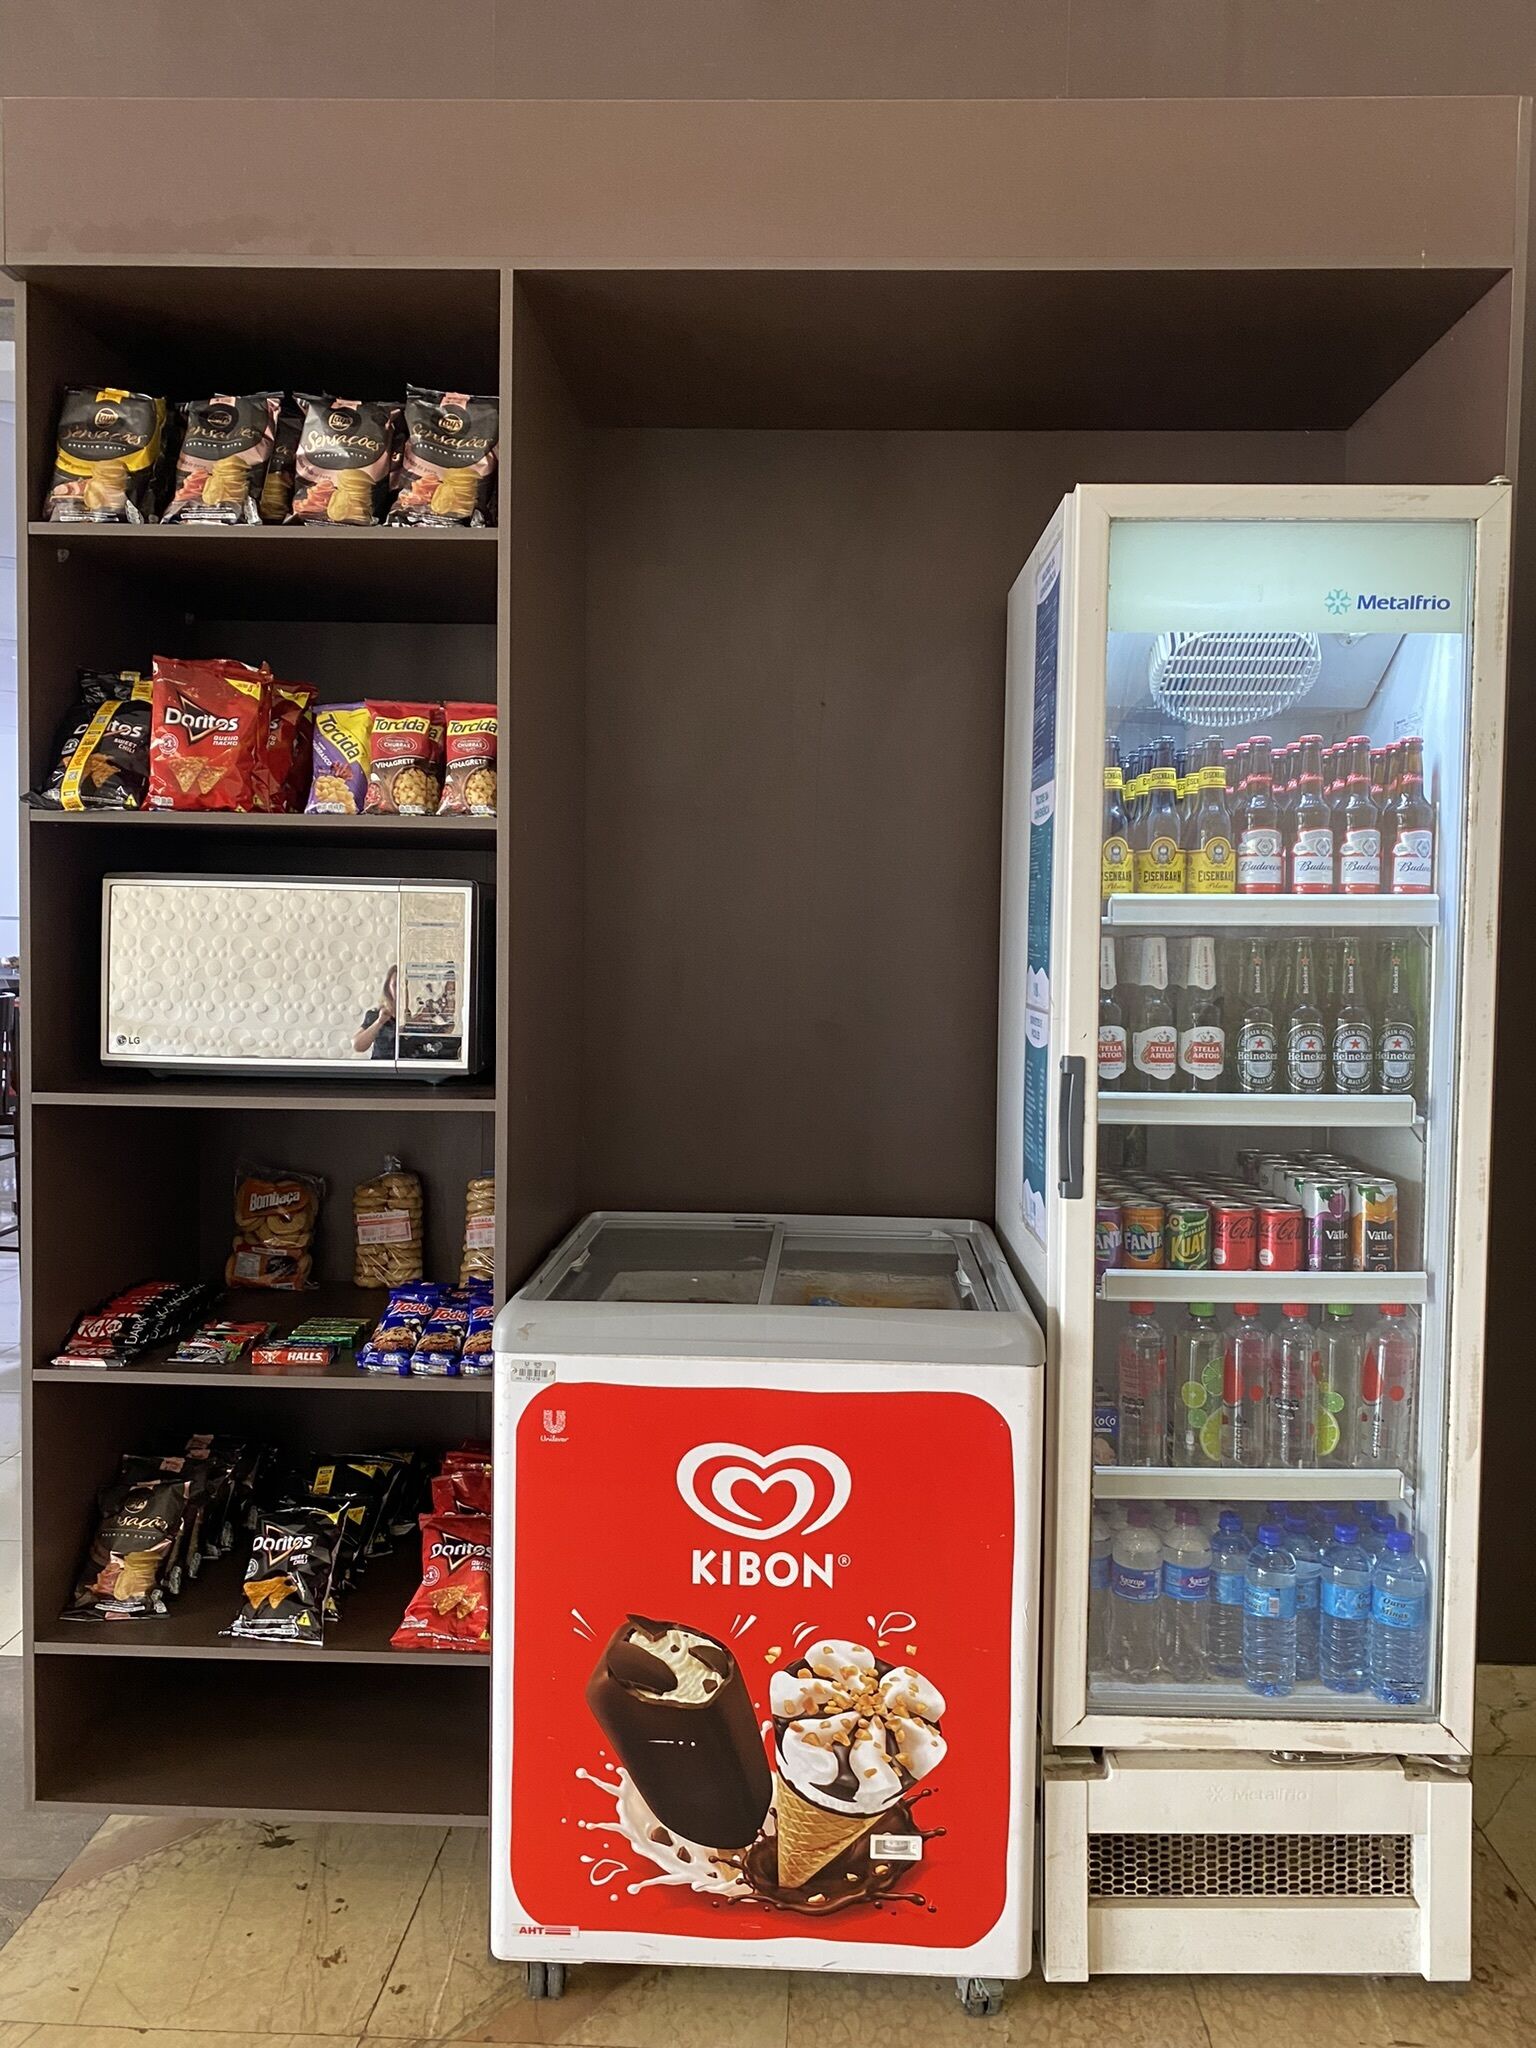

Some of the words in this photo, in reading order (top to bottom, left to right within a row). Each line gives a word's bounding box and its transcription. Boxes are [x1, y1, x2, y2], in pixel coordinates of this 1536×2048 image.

[304, 430, 382, 452] Sensações
[1357, 594, 1451, 610] Metalfrio
[165, 707, 239, 732] Doritos
[375, 718, 425, 732] Torcida
[449, 720, 498, 734] Torcida
[319, 713, 360, 760] Torcida
[1143, 871, 1182, 883] EISENBAHN
[128, 1036, 140, 1045] LG
[249, 1191, 300, 1212] Bombaça
[1171, 1230, 1207, 1262] KUAT
[394, 1301, 432, 1315] Toddy
[124, 1316, 150, 1345] DARK
[287, 1351, 323, 1361] HALLS
[253, 1535, 314, 1551] Doritos
[430, 1544, 492, 1559] Doritos
[1383, 1597, 1407, 1609] Ouro
[519, 1926, 545, 1935] AHT
